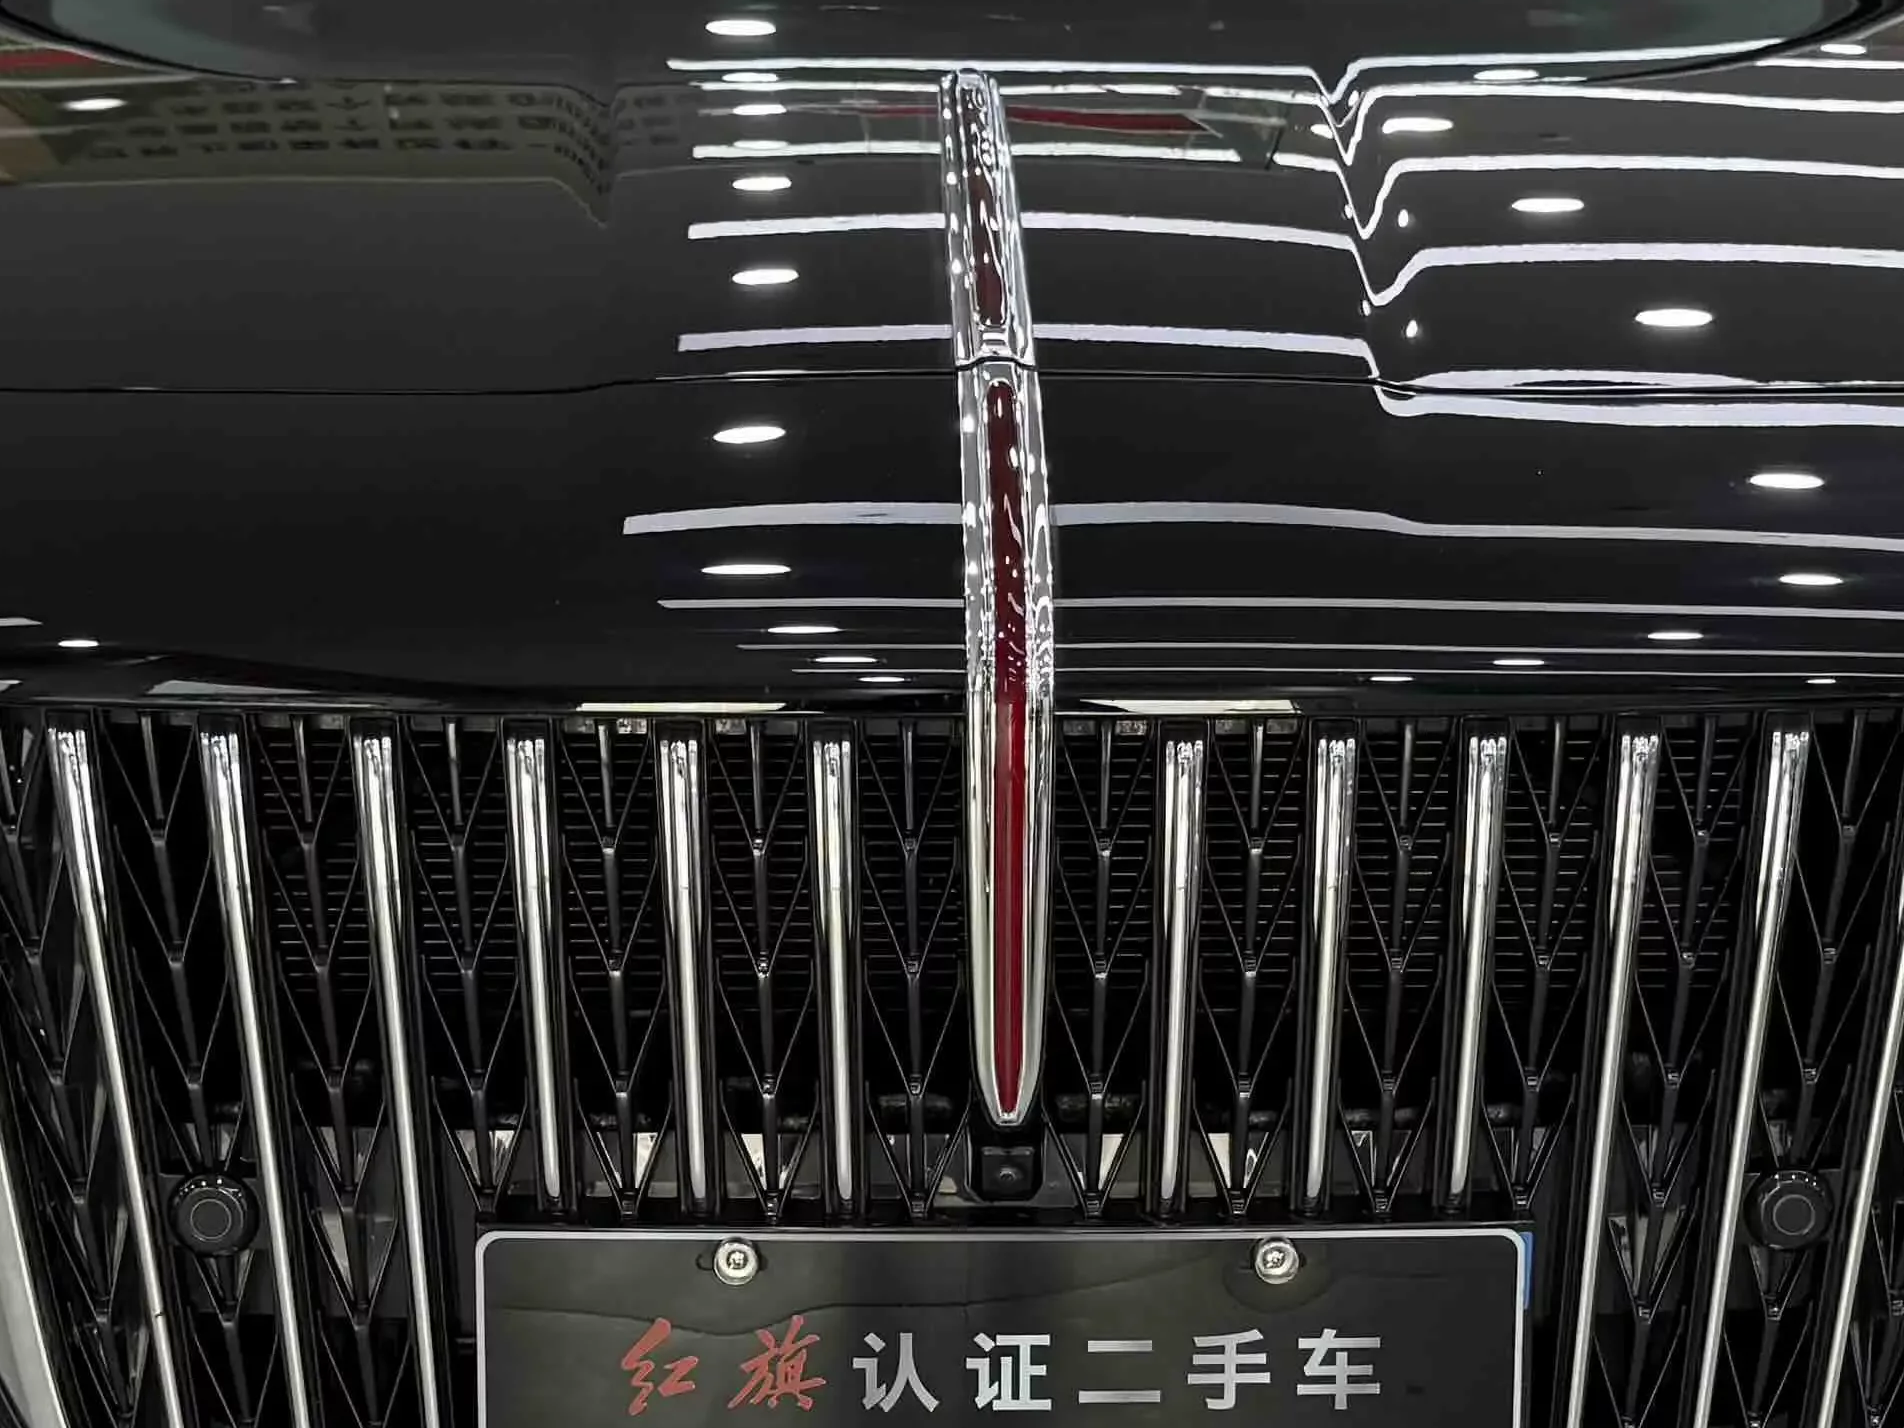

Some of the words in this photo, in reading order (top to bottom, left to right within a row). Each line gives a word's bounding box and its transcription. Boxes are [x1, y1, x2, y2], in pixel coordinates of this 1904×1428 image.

[621, 1315, 1382, 1416] 红旗认证二手车
